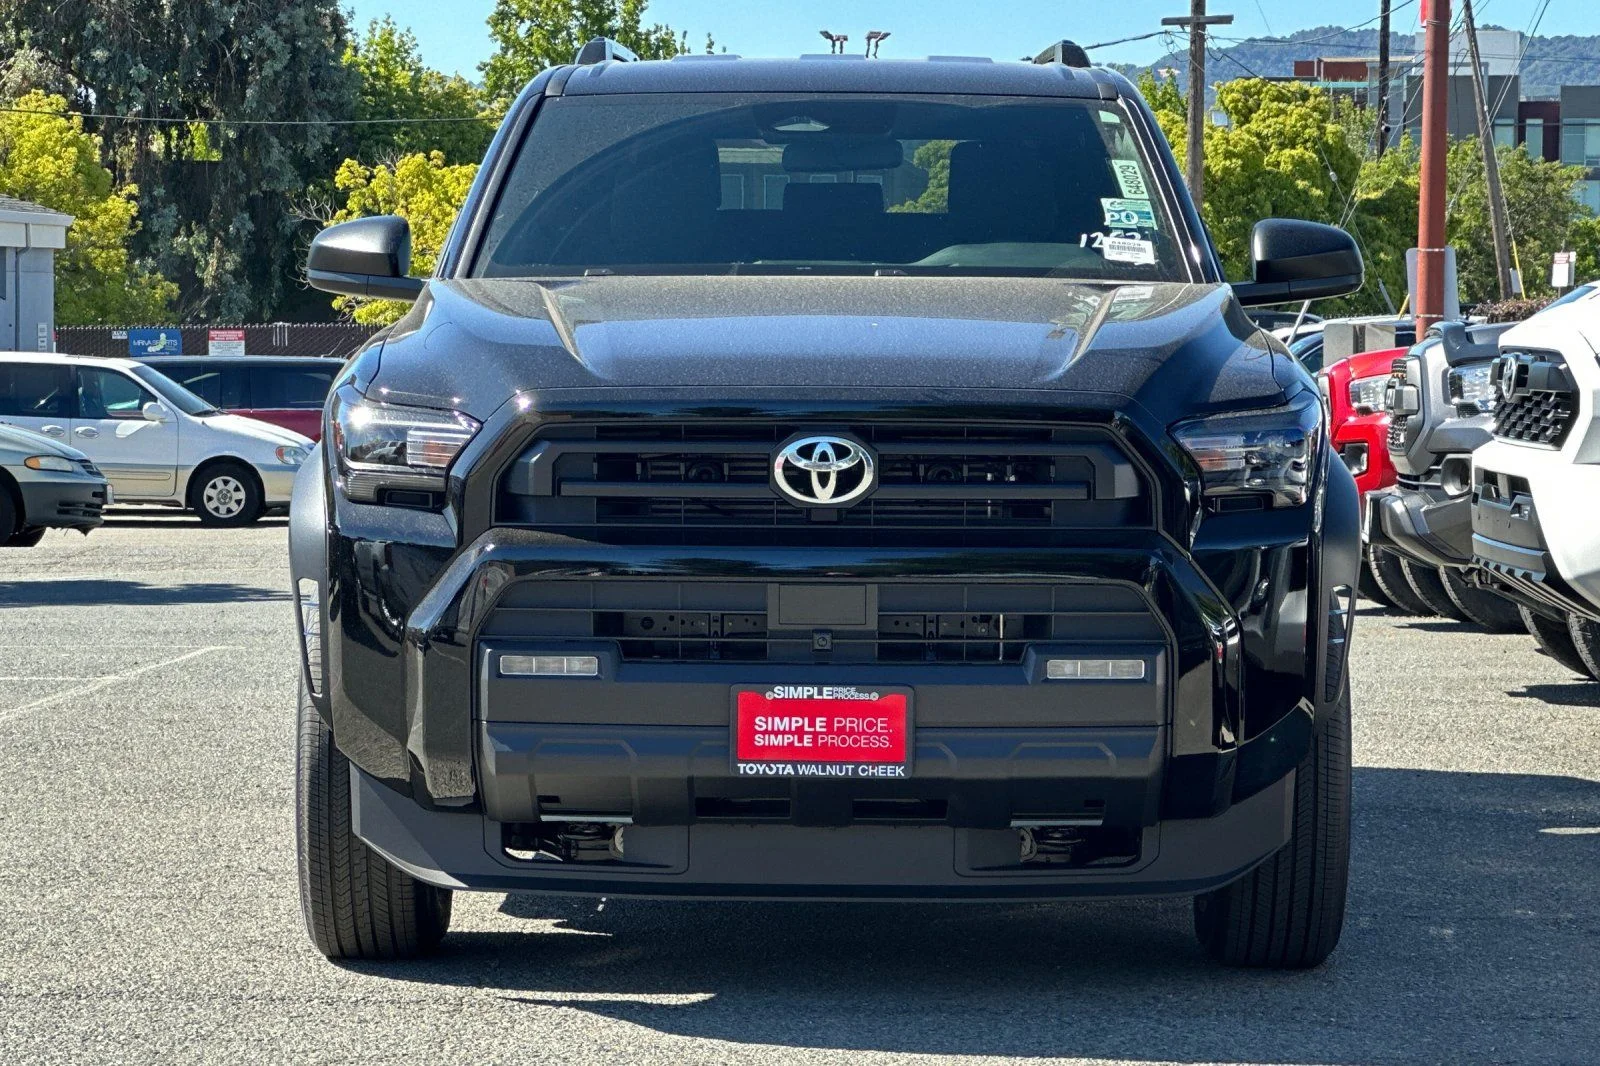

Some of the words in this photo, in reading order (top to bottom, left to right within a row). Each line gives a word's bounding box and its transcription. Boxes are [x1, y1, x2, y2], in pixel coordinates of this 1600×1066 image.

[1119, 164, 1145, 195] 648029
[774, 686, 833, 699] SIMPLE
[754, 716, 826, 732] SIMPLE
[834, 718, 892, 732] PRICE.
[754, 734, 812, 746] SIMPLE
[818, 735, 892, 748] PROCESS.
[738, 764, 794, 775] TOYOTA
[798, 764, 854, 776] WALNUT
[858, 766, 904, 776] CHEEK
